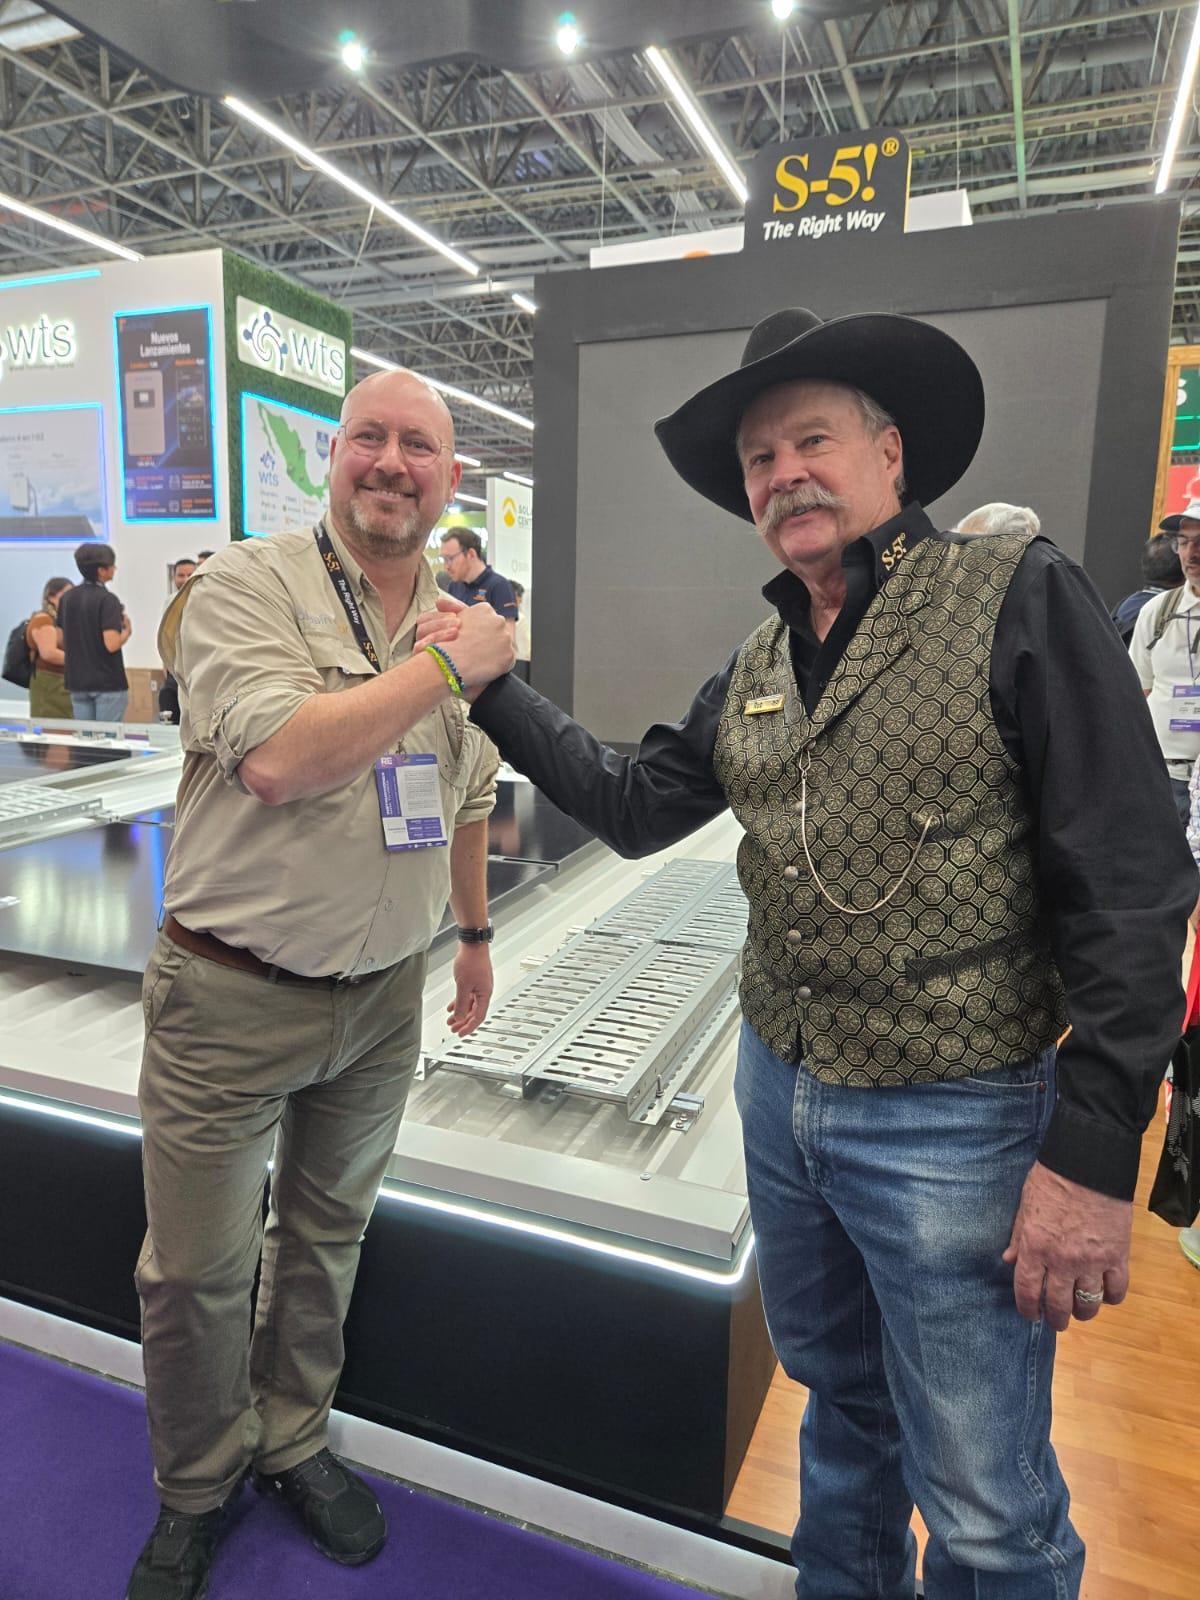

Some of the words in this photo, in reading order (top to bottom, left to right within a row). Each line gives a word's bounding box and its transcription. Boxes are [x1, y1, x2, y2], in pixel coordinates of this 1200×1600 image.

[763, 220, 794, 241] The
[797, 212, 842, 240] Right
[846, 209, 886, 232] Way
[6, 317, 73, 361] wts
[139, 342, 191, 358] Lanzamientos
[150, 331, 179, 345] Nuevos
[291, 331, 345, 381] wts
[258, 471, 279, 487] wts
[338, 579, 347, 592] The
[343, 591, 356, 611] Right
[350, 608, 361, 624] Way
